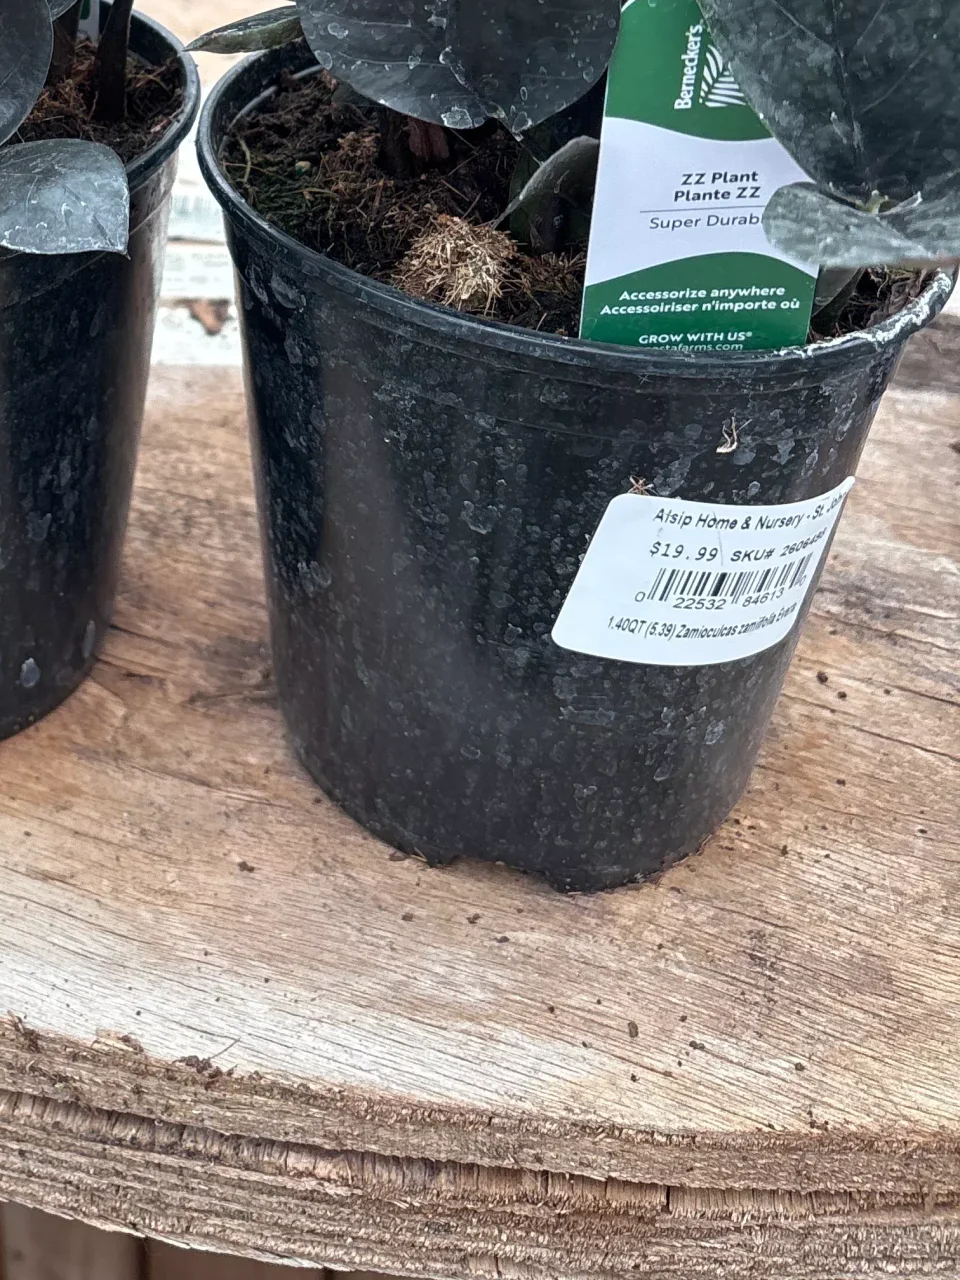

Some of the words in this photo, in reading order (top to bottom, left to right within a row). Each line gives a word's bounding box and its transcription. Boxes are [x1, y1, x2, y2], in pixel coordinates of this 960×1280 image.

[674, 24, 702, 109] Bernecker's
[681, 173, 706, 186] ZZ
[711, 171, 759, 184] Plant
[674, 190, 731, 202] Plante
[736, 186, 761, 199] ZZ
[649, 217, 701, 231] Super
[707, 213, 760, 227] Durab
[619, 287, 707, 301] Accessorize
[710, 285, 786, 299] anywhere
[600, 301, 698, 315] Accessoiriser
[702, 300, 776, 313] n'importe
[780, 298, 800, 309] où
[638, 333, 684, 344] GROW
[687, 332, 724, 342] WITH
[653, 508, 692, 529] Alsip
[695, 513, 738, 530] Home
[741, 515, 752, 530] &
[754, 514, 805, 531] Nursery
[649, 541, 718, 562] $19.99
[730, 548, 776, 562] SKU#
[634, 591, 646, 602] 0
[672, 597, 727, 610] 22532
[742, 587, 785, 607] 84613
[608, 615, 647, 634] 1.40QT
[644, 621, 677, 641] (5.39)
[675, 624, 738, 639] Zamioculcas
